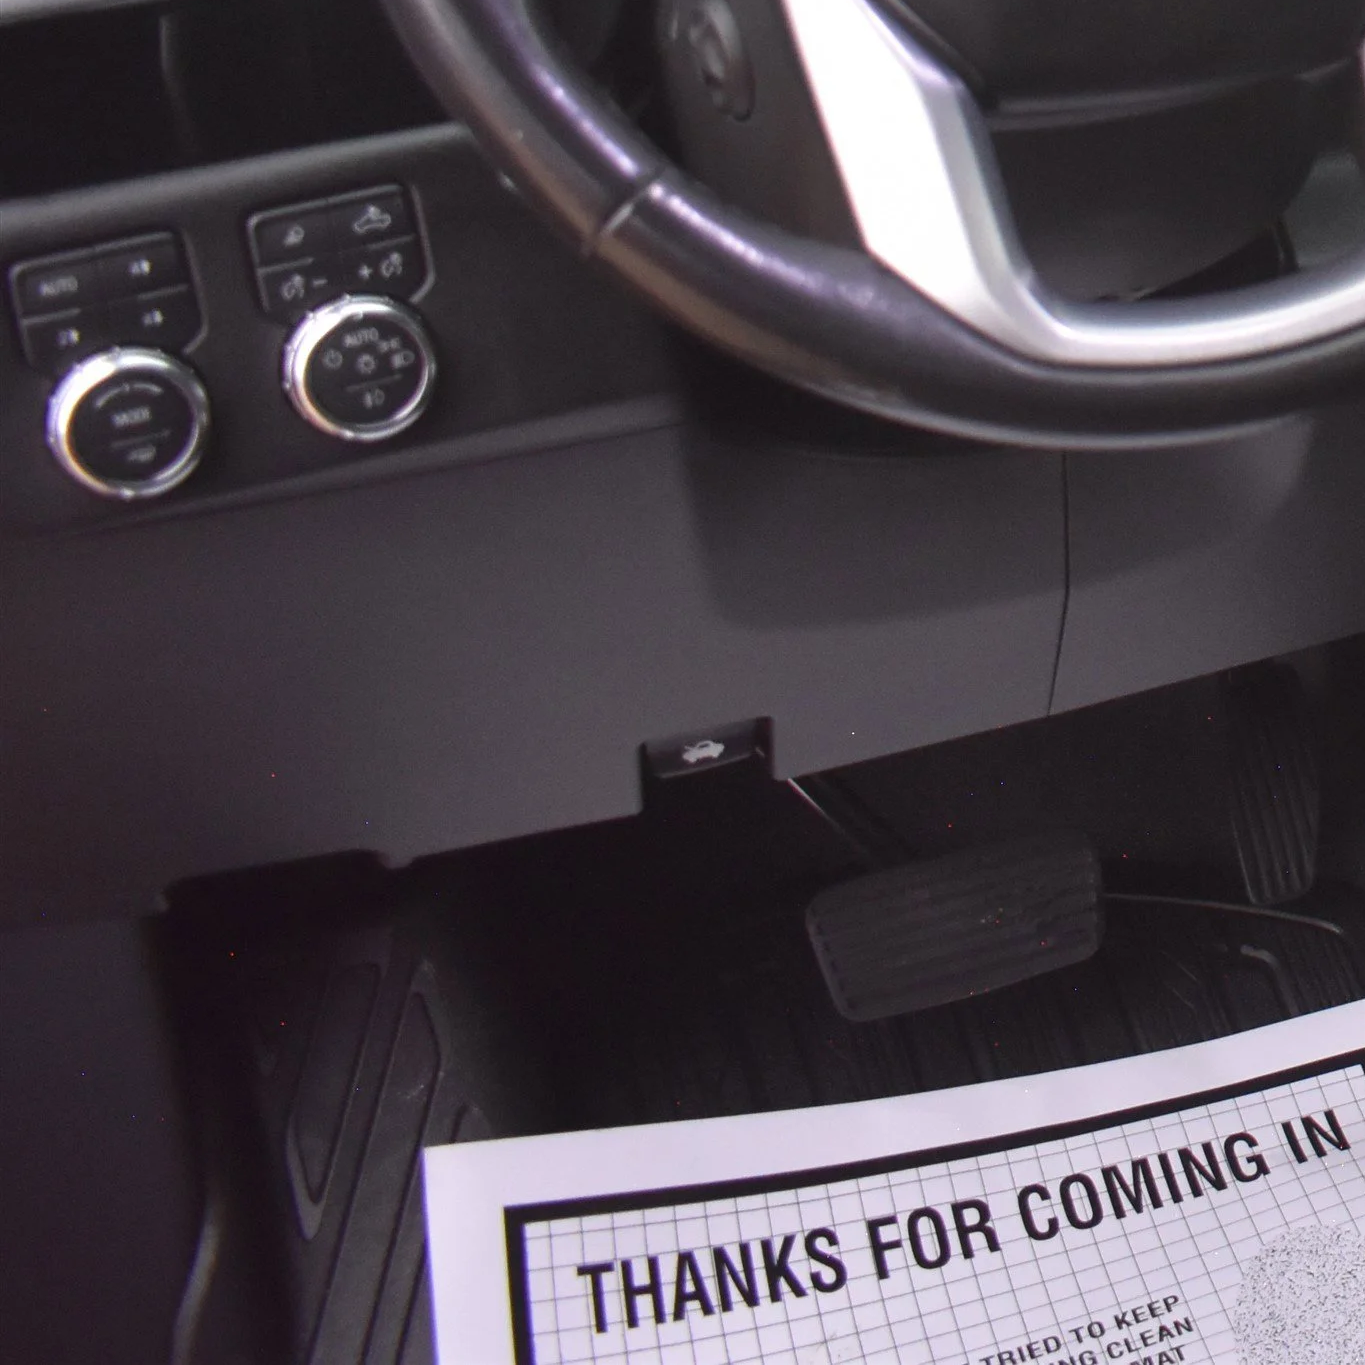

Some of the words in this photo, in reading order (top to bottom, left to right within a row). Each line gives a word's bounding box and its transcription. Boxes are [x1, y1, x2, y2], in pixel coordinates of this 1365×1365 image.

[344, 328, 379, 348] AUTO
[577, 1227, 847, 1333] THANKS
[867, 1198, 1001, 1280] FOR
[1017, 1131, 1271, 1241] COMING
[1281, 1109, 1351, 1164] IN
[979, 1335, 1062, 1365] TRIED
[1069, 1321, 1106, 1344] TO
[1113, 1294, 1181, 1331] KEEP
[1106, 1317, 1194, 1359] CLEAN
